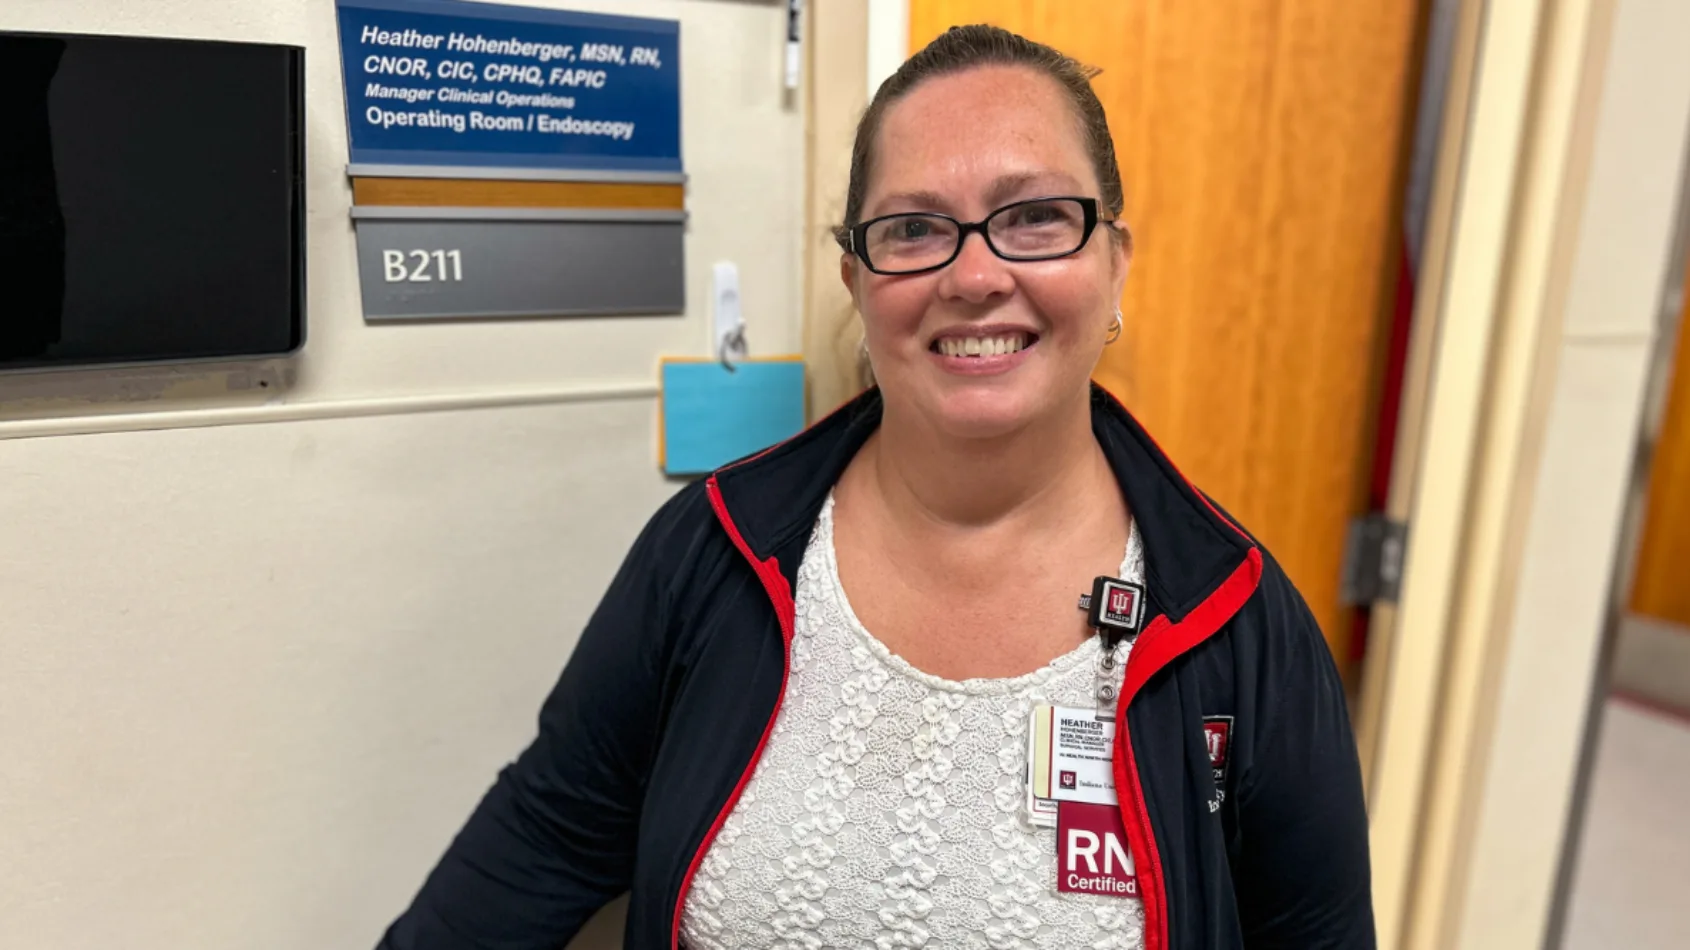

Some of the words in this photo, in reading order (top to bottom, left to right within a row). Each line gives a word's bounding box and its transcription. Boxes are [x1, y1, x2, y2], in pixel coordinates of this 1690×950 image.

[361, 25, 443, 50] Heather
[447, 32, 576, 63] Hohenberger,
[579, 43, 627, 66] MSN,
[629, 47, 661, 69] RN,
[363, 55, 432, 80] CNOR,
[437, 60, 478, 83] CIC,
[483, 63, 546, 87] CPHQ,
[549, 68, 607, 89] FAPIC
[365, 83, 435, 104] Manager
[437, 87, 493, 105] Clinical
[496, 90, 575, 109] Operations
[366, 106, 466, 133] Operating
[469, 113, 524, 132] Room
[526, 114, 534, 131] /
[537, 114, 635, 140] Endoscopy
[382, 249, 463, 282] B211
[1060, 718, 1103, 730] HEATHER
[1067, 828, 1136, 877] RN
[1067, 873, 1136, 894] Certified
